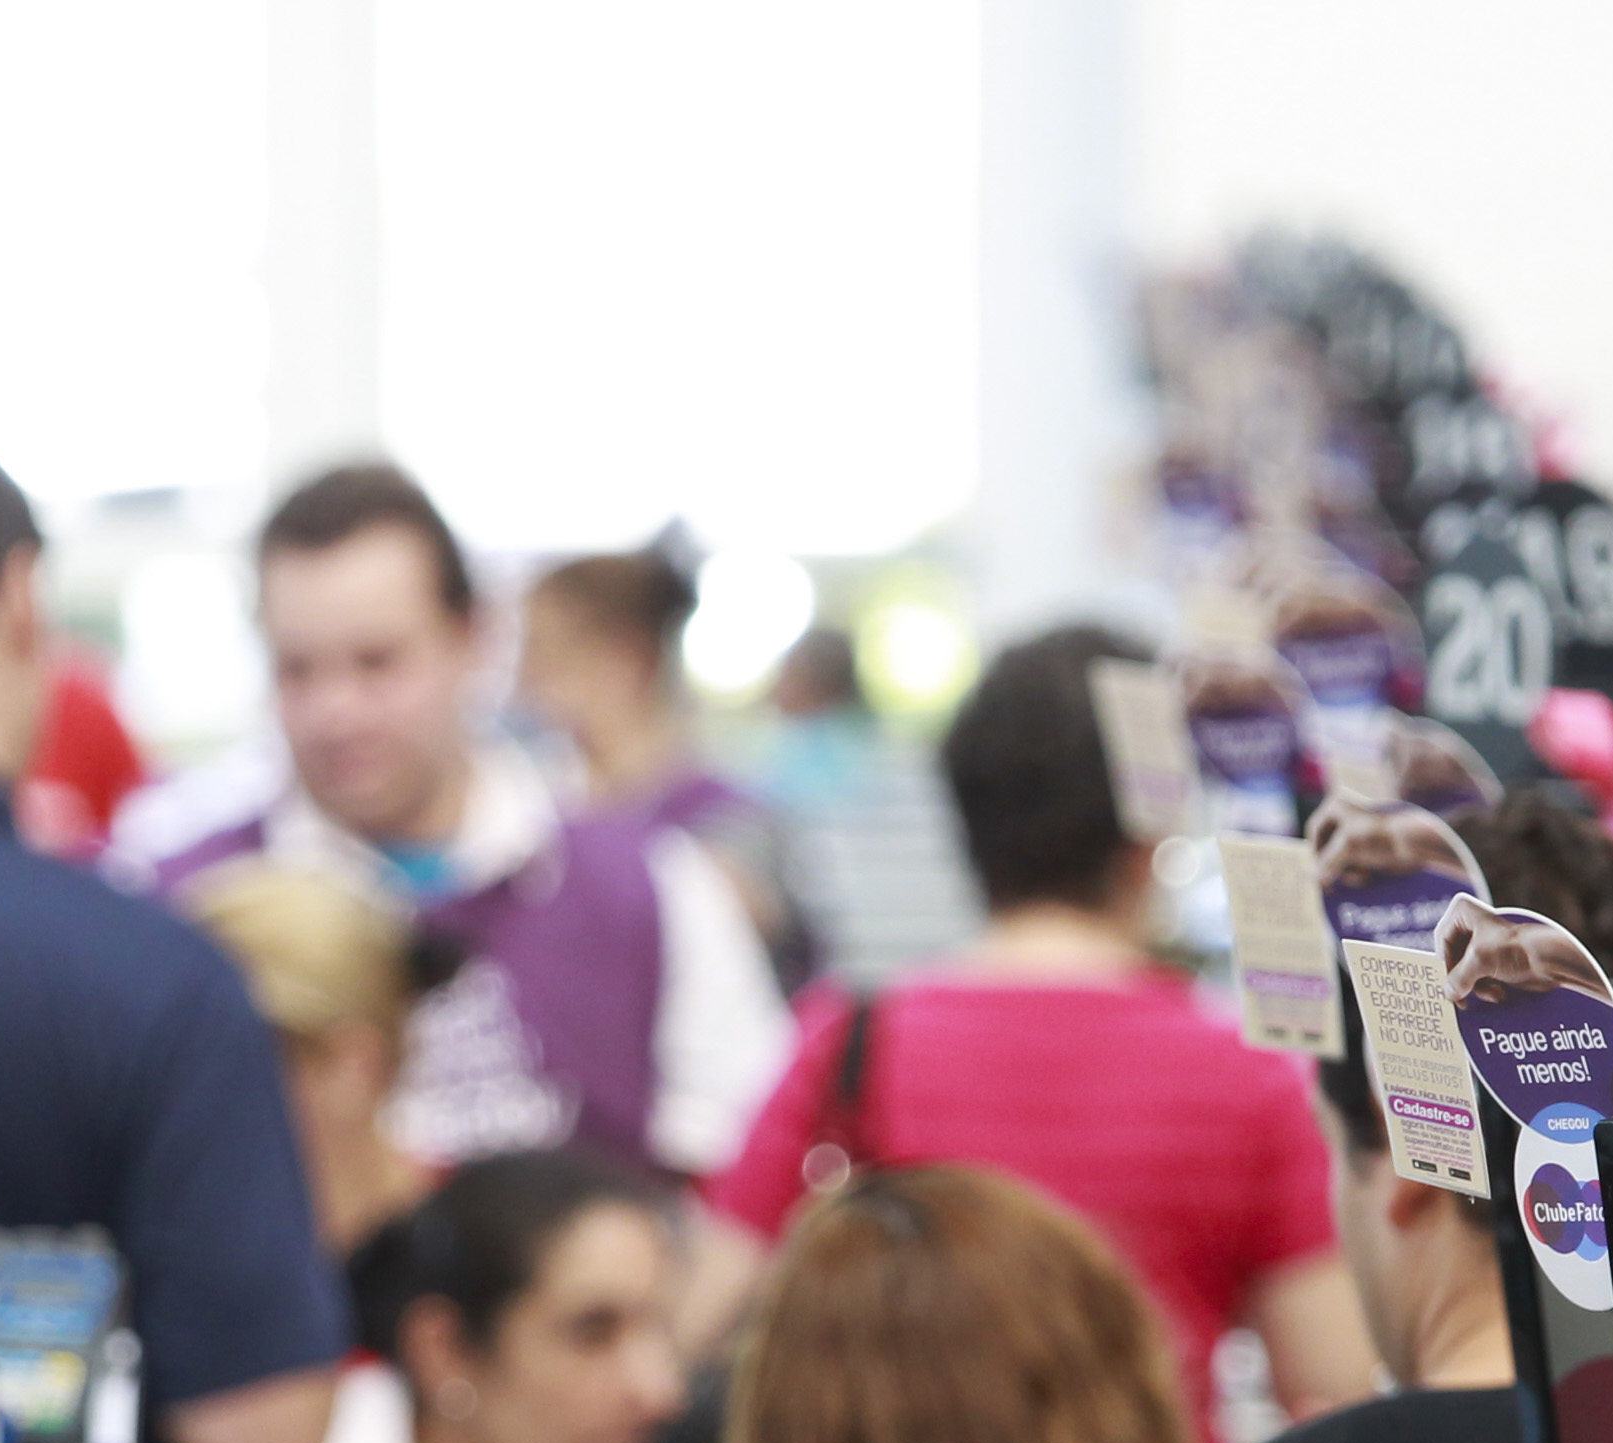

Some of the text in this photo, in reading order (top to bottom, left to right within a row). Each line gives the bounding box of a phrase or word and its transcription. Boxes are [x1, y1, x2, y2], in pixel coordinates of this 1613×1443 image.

[1423, 573, 1552, 727] 20
[1359, 956, 1439, 982] COMPROVE:
[1361, 973, 1446, 1000] O VALOR DA
[1370, 991, 1444, 1017] ECONOMIA
[1379, 1009, 1443, 1035] APARECE
[1379, 1026, 1456, 1055] NO CUPOM!
[1478, 1023, 1608, 1060] Pague ainda
[1516, 1055, 1592, 1085] menos!
[1393, 1098, 1470, 1127] Cadastre-se
[1547, 1117, 1589, 1131] CHEGOU
